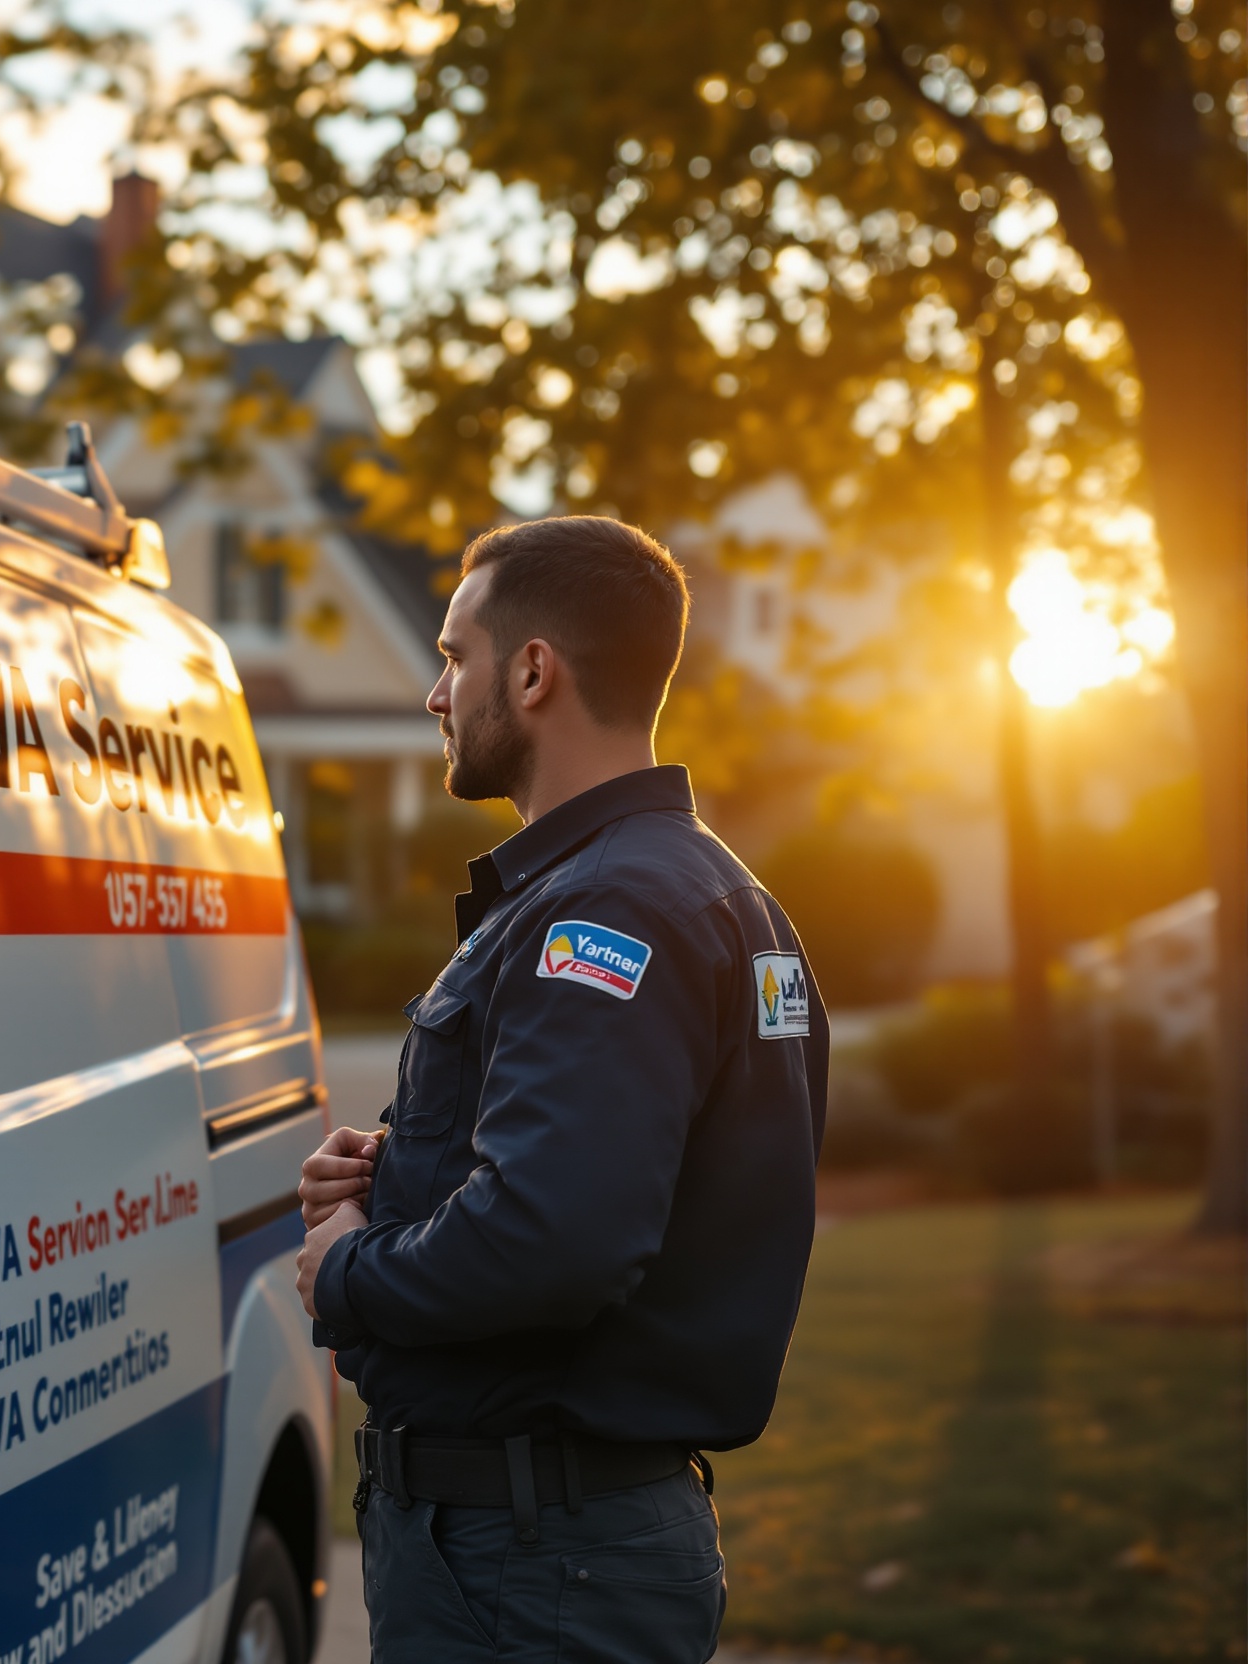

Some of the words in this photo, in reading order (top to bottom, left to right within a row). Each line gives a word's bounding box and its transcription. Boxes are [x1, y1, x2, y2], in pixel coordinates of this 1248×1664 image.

[58, 677, 246, 828] Service
[577, 934, 641, 974] Yartner
[27, 1201, 110, 1272] Servion
[35, 1543, 86, 1609] Save
[91, 1518, 109, 1572] &
[28, 1601, 68, 1664] and
